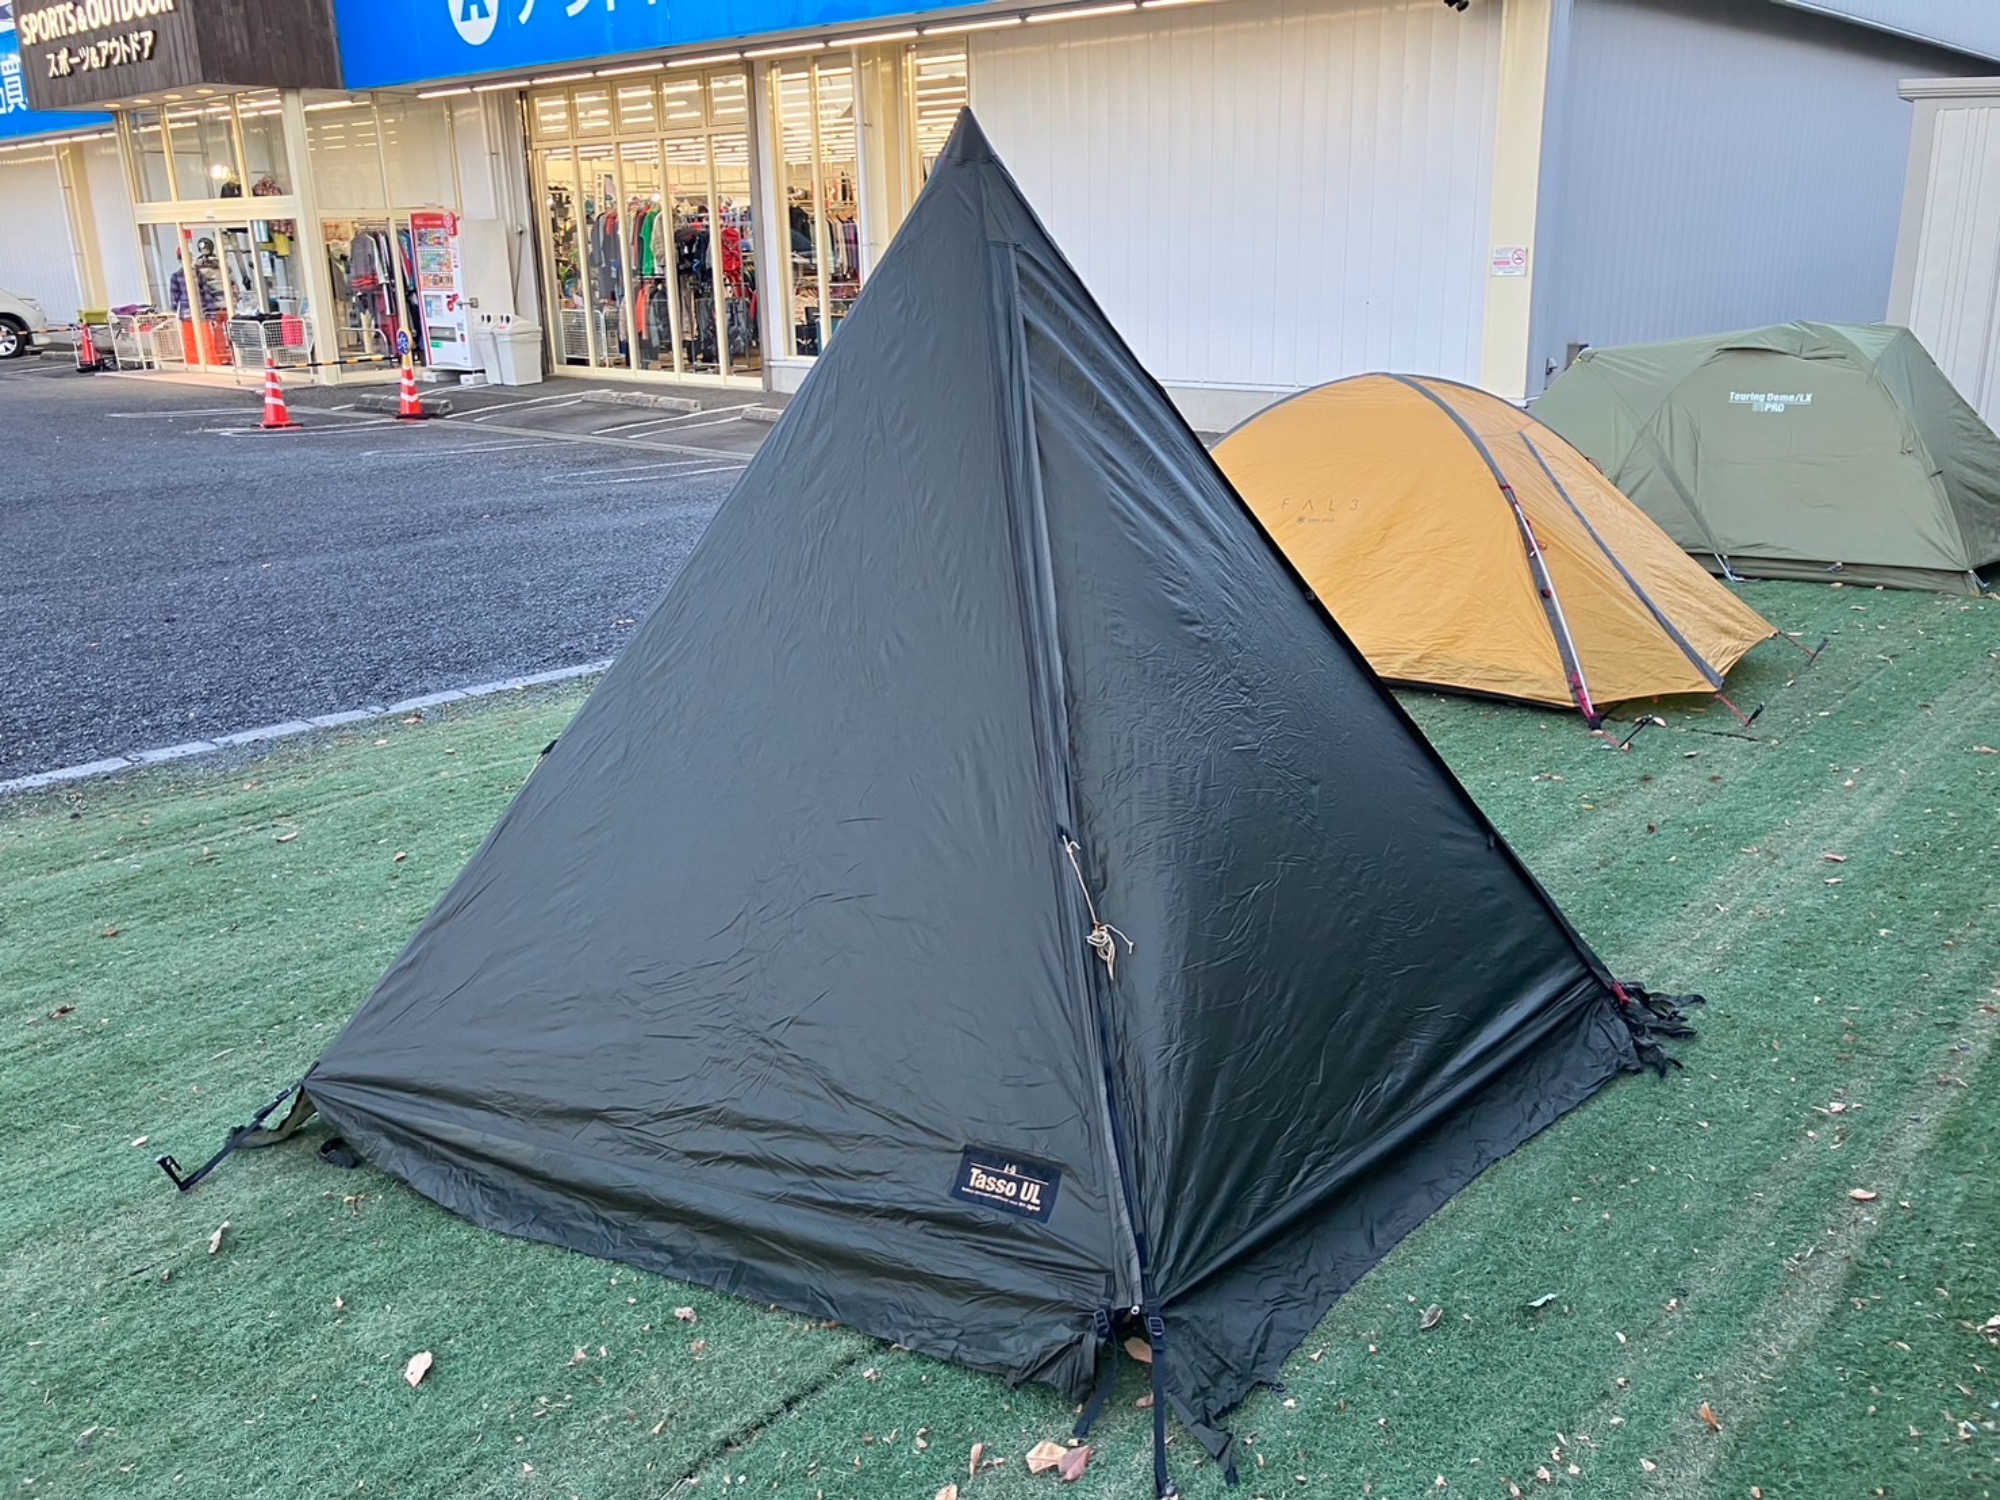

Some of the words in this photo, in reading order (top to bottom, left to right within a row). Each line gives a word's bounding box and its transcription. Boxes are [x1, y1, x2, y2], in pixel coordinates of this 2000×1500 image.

[45, 30, 154, 77] スポーツ&アウトドア
[1729, 391, 1766, 403] Touring
[1766, 392, 1813, 404] Dome/LX
[969, 1167, 1017, 1197] Tasso
[1019, 1181, 1041, 1205] UL
